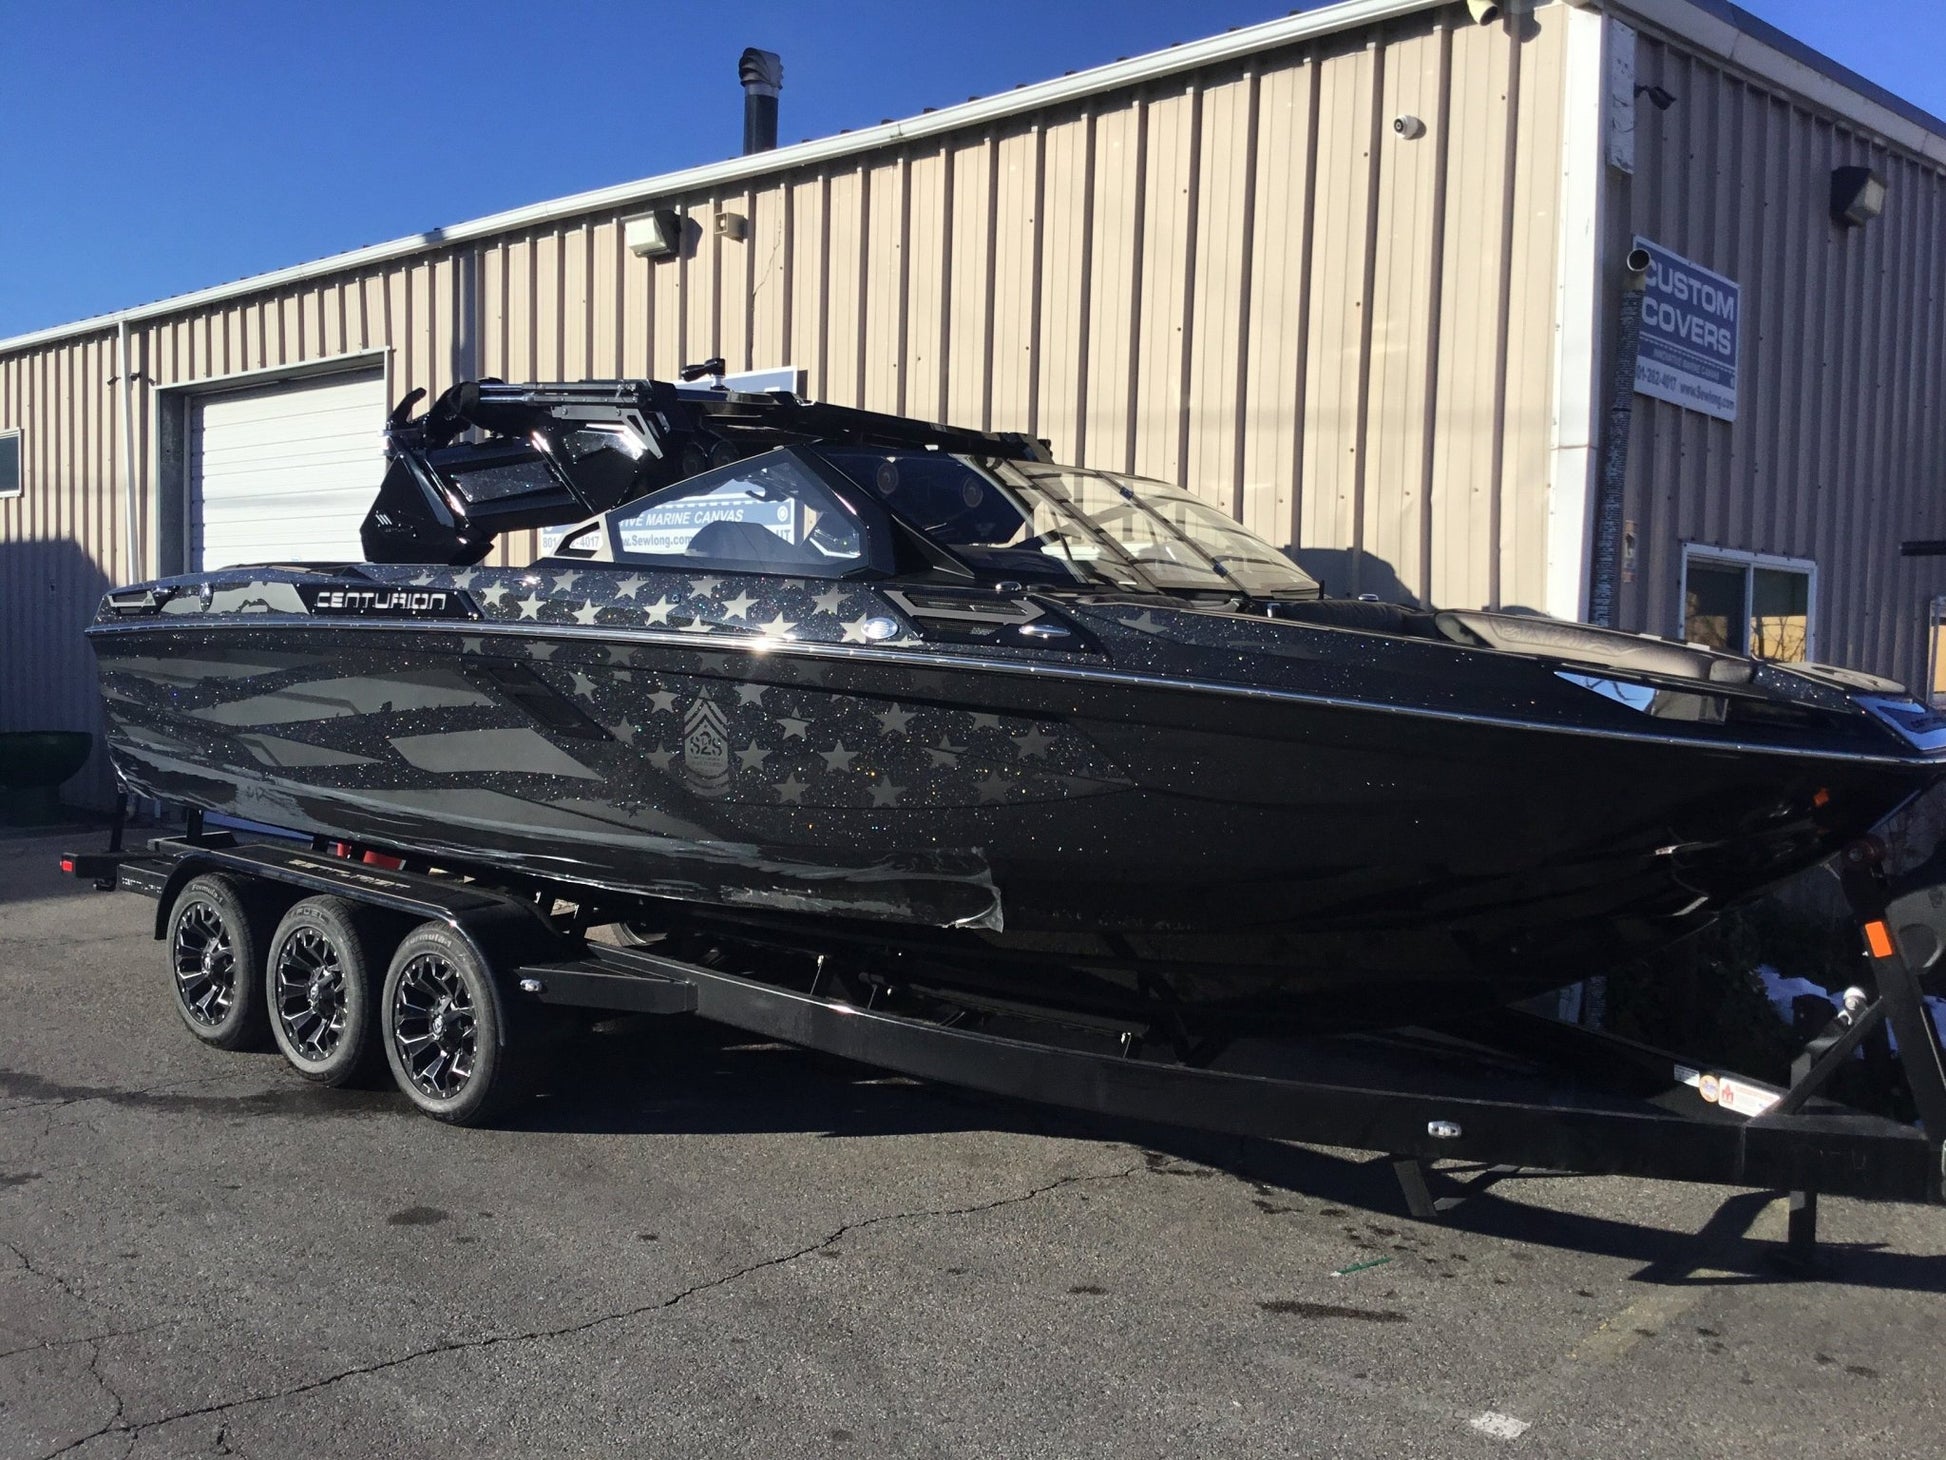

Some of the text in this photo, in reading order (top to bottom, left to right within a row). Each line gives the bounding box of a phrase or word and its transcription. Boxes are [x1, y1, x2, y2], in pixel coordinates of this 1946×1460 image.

[1645, 259, 1734, 322] CUSTOM
[1641, 296, 1731, 355] COVERS
[646, 511, 692, 526] MARINE
[694, 509, 744, 524] CANVAS
[316, 591, 447, 611] CENTURION
